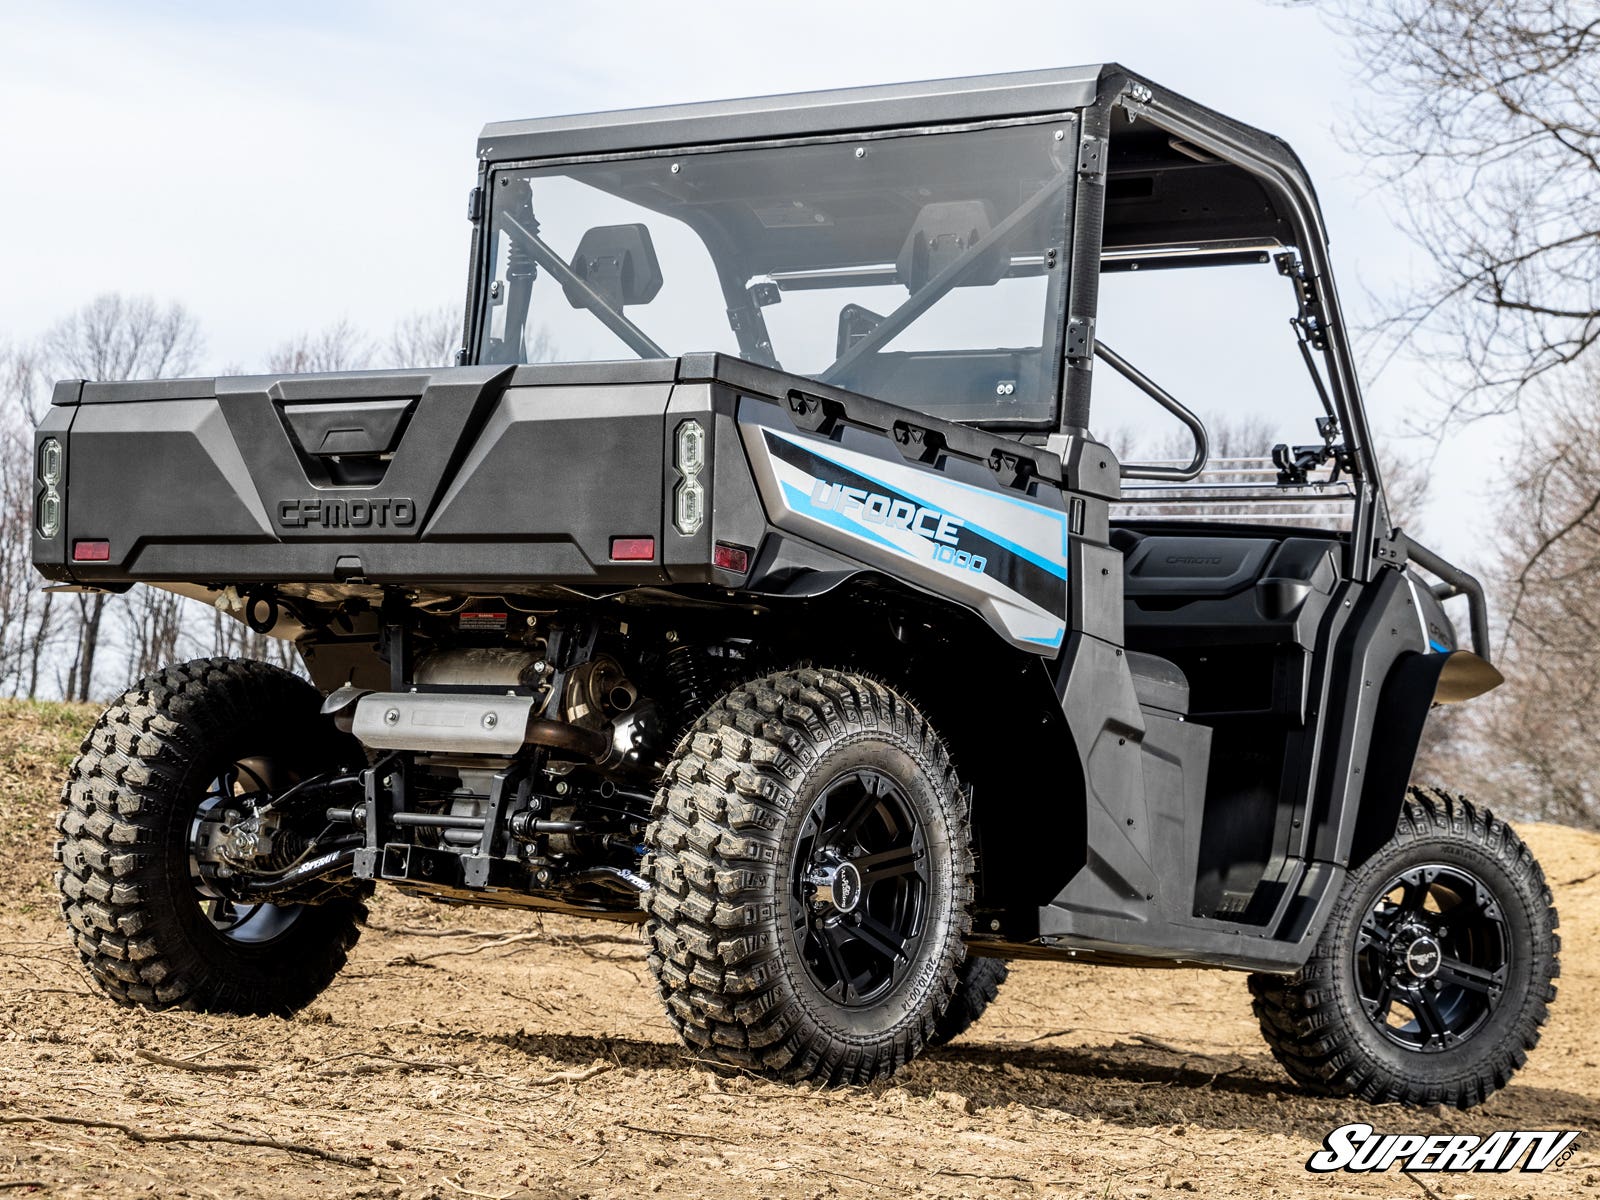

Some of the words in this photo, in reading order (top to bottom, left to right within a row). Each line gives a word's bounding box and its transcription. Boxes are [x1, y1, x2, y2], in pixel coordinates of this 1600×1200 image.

[277, 498, 416, 528] CFMOTO
[810, 478, 965, 546] UFORCE
[932, 542, 987, 573] 1000
